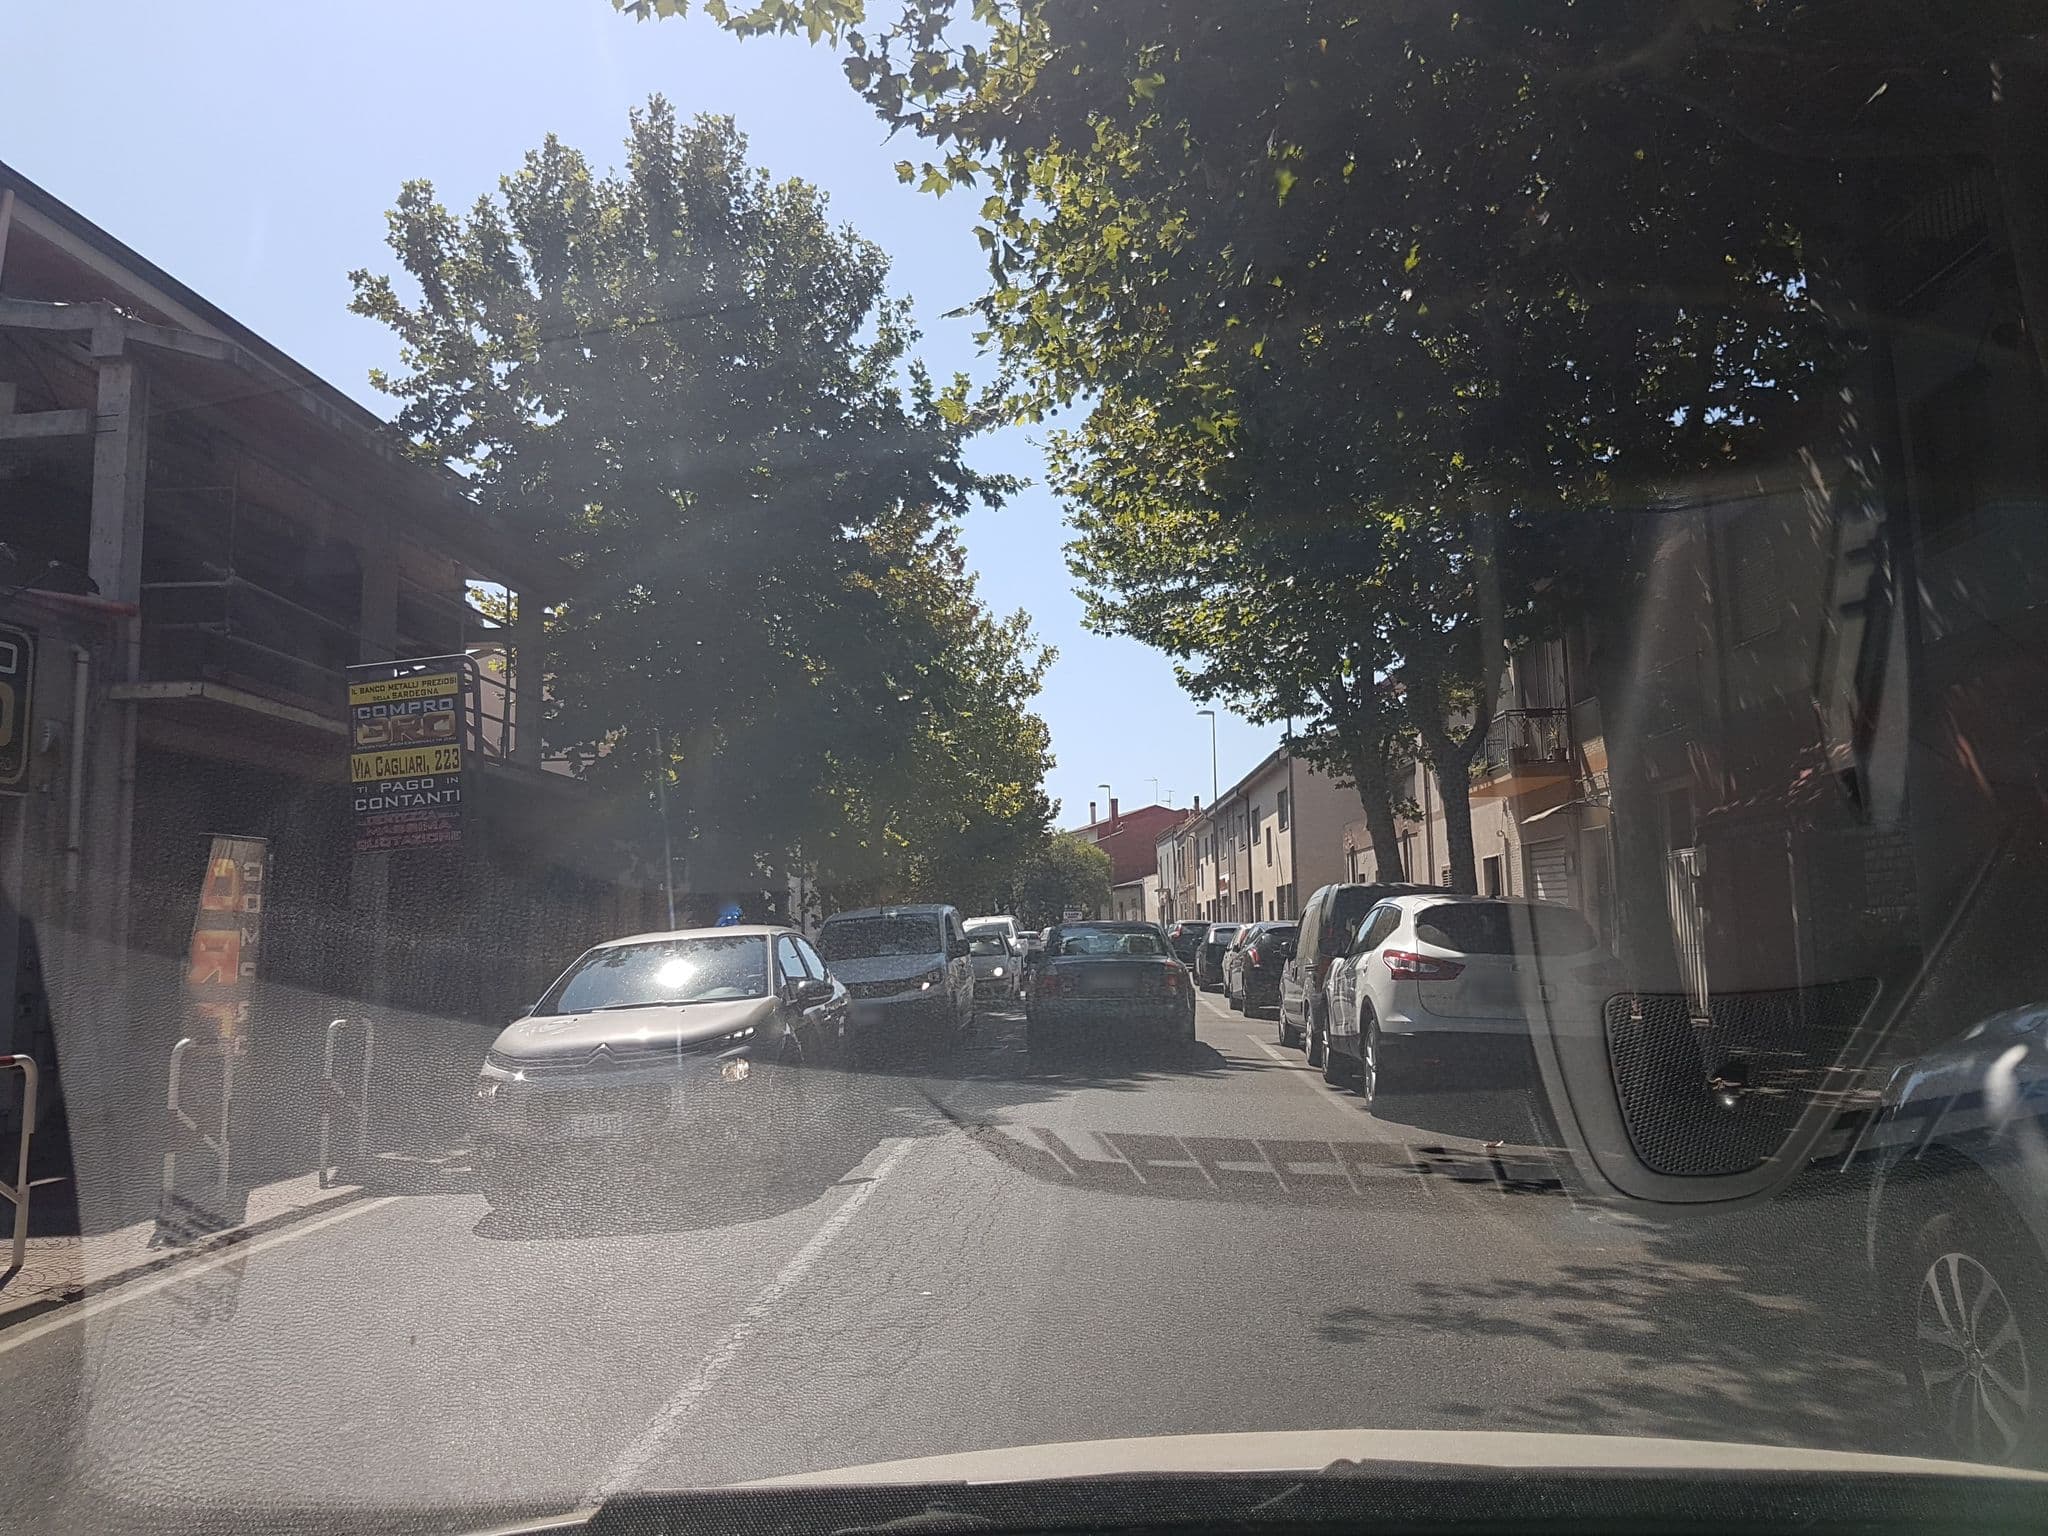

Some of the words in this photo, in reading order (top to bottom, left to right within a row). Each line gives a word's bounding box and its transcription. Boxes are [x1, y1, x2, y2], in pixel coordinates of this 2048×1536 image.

[359, 685, 386, 695] BANCO
[388, 682, 419, 691] METALLI
[421, 677, 457, 687] PREZIOSI
[392, 688, 439, 697] SARDEGNA
[357, 698, 454, 719] COMPRO
[356, 710, 456, 745] ORO
[352, 758, 372, 779] VIA
[375, 755, 430, 776] CAGLIARI,
[434, 748, 460, 771] 223
[380, 778, 434, 793] PAGO
[446, 776, 459, 784] IN
[355, 789, 460, 811] CONTANTI
